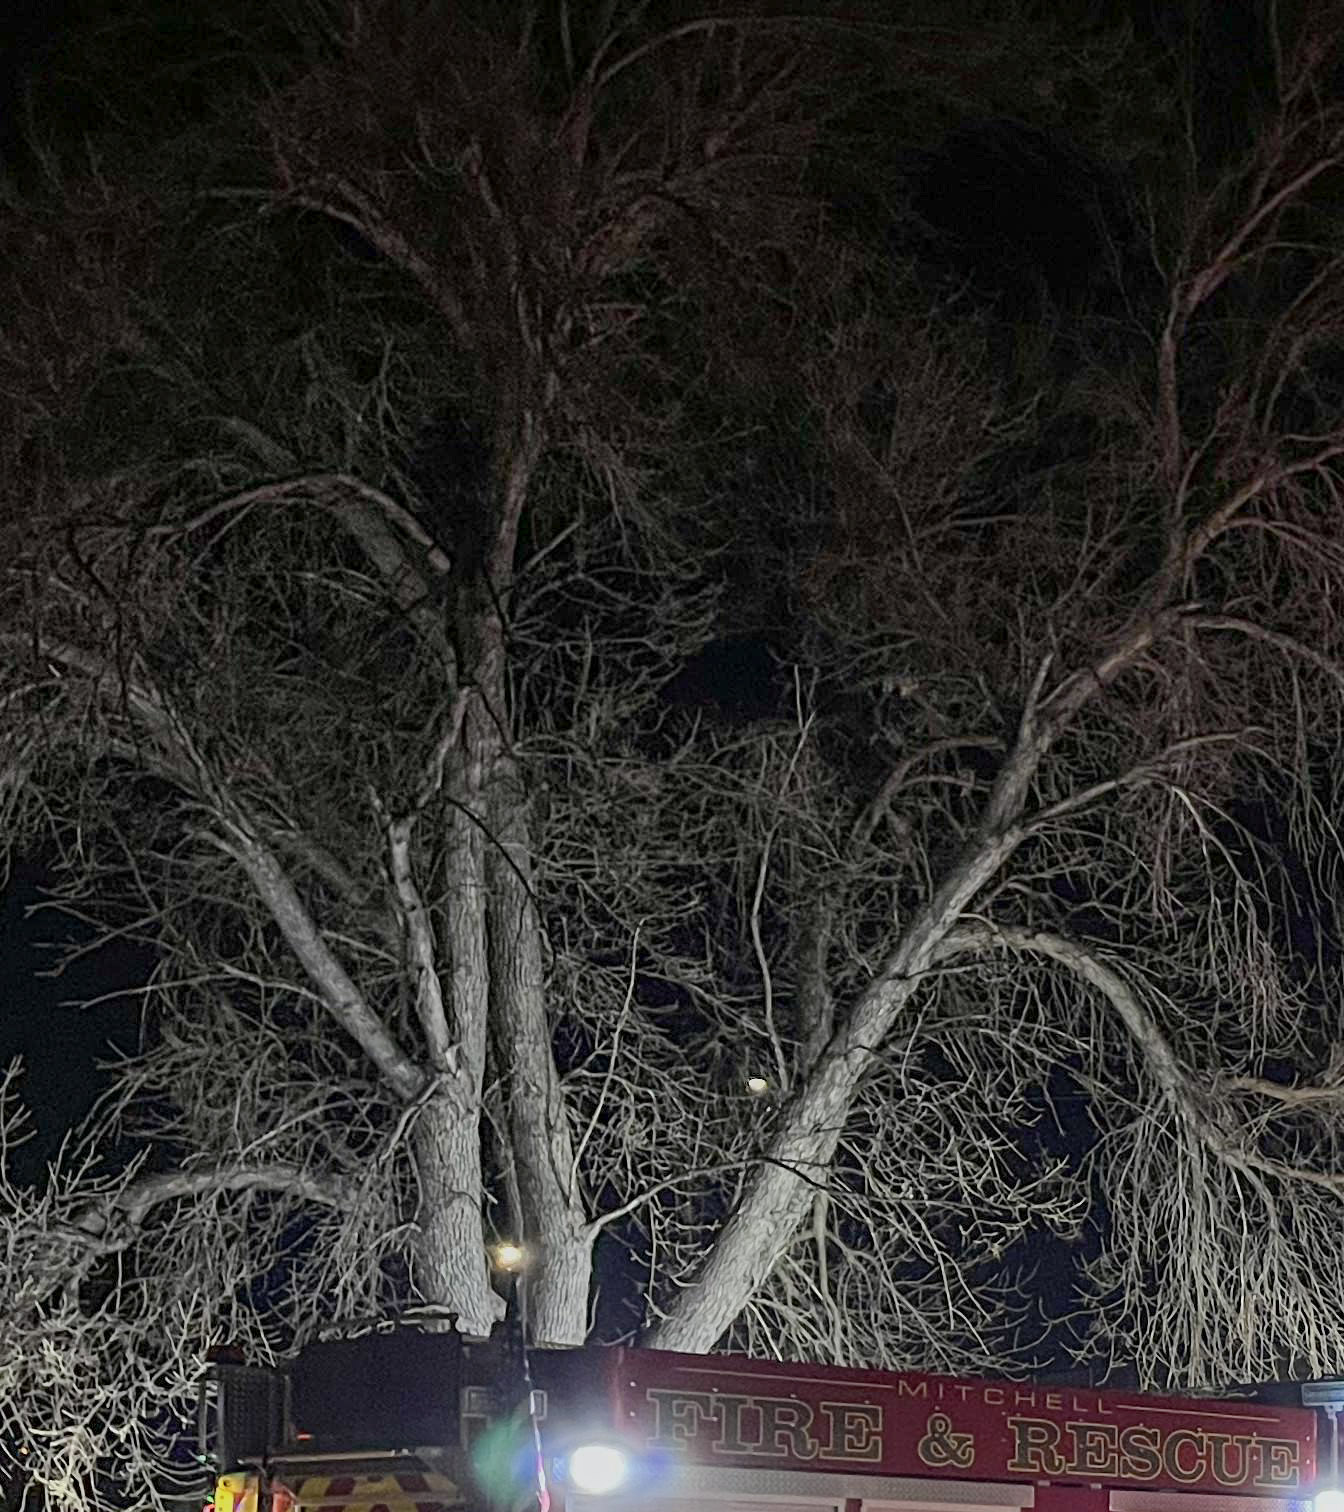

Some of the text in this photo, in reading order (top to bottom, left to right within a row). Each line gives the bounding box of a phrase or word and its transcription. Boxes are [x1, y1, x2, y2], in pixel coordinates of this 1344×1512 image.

[897, 1379, 1113, 1414] MITCHELL
[646, 1388, 1300, 1488] FIRE & RESCUE
